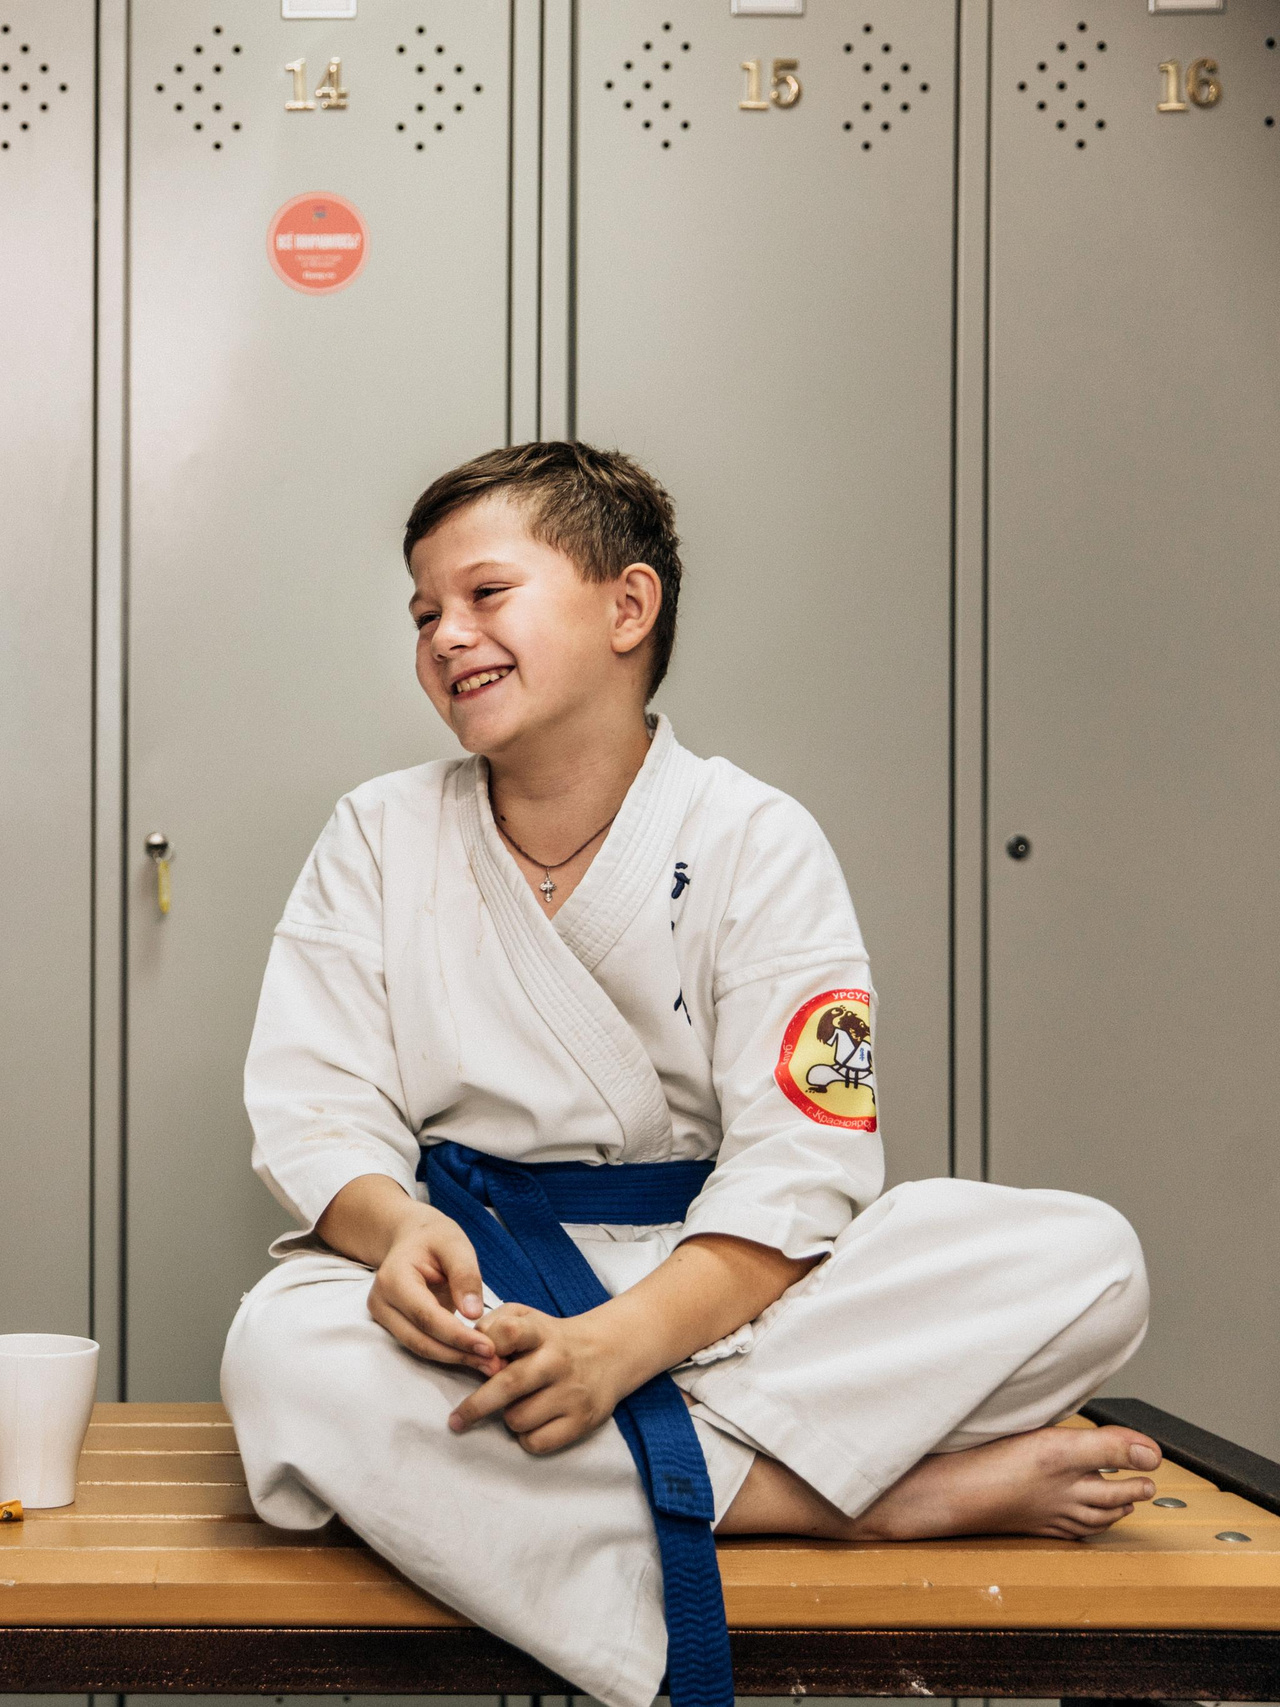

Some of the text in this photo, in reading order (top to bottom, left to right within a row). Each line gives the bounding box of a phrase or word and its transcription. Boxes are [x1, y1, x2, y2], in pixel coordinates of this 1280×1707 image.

[283, 57, 349, 111] 14
[738, 58, 803, 110] 15
[1157, 58, 1224, 112] 16
